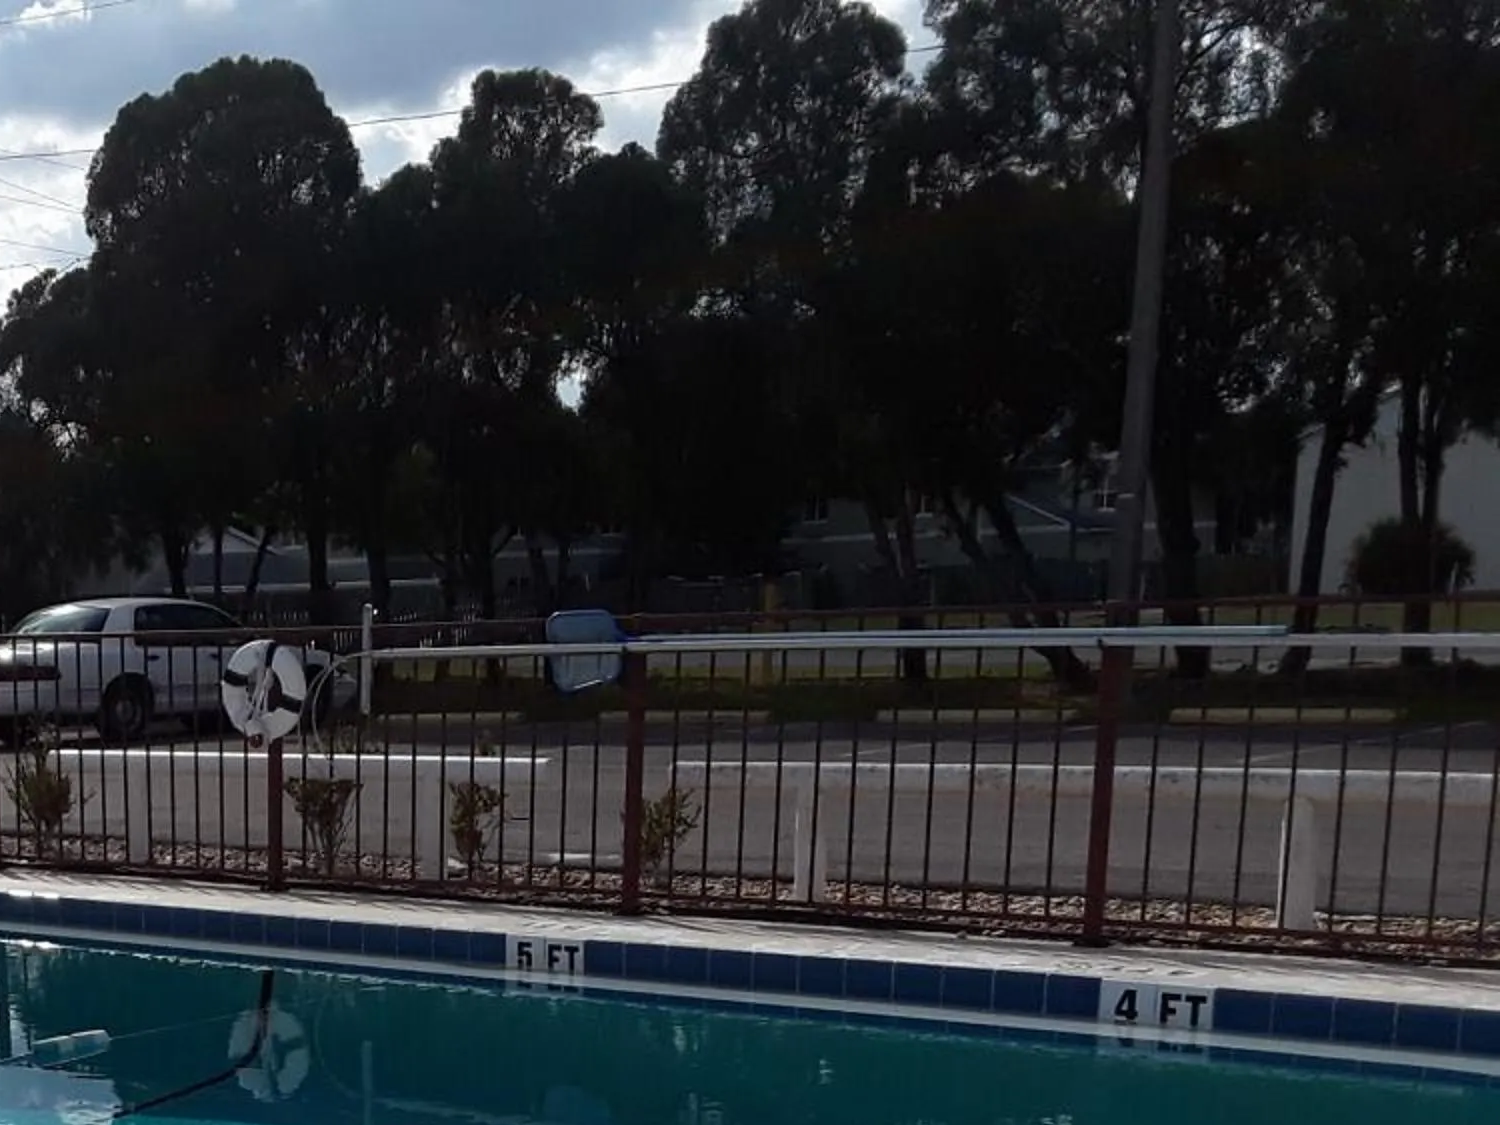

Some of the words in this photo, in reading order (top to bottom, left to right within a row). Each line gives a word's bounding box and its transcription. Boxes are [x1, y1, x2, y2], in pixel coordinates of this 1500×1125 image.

[517, 941, 532, 973] 5
[547, 944, 579, 976] FT
[1114, 989, 1138, 1024] 4
[1159, 992, 1207, 1027] FT
